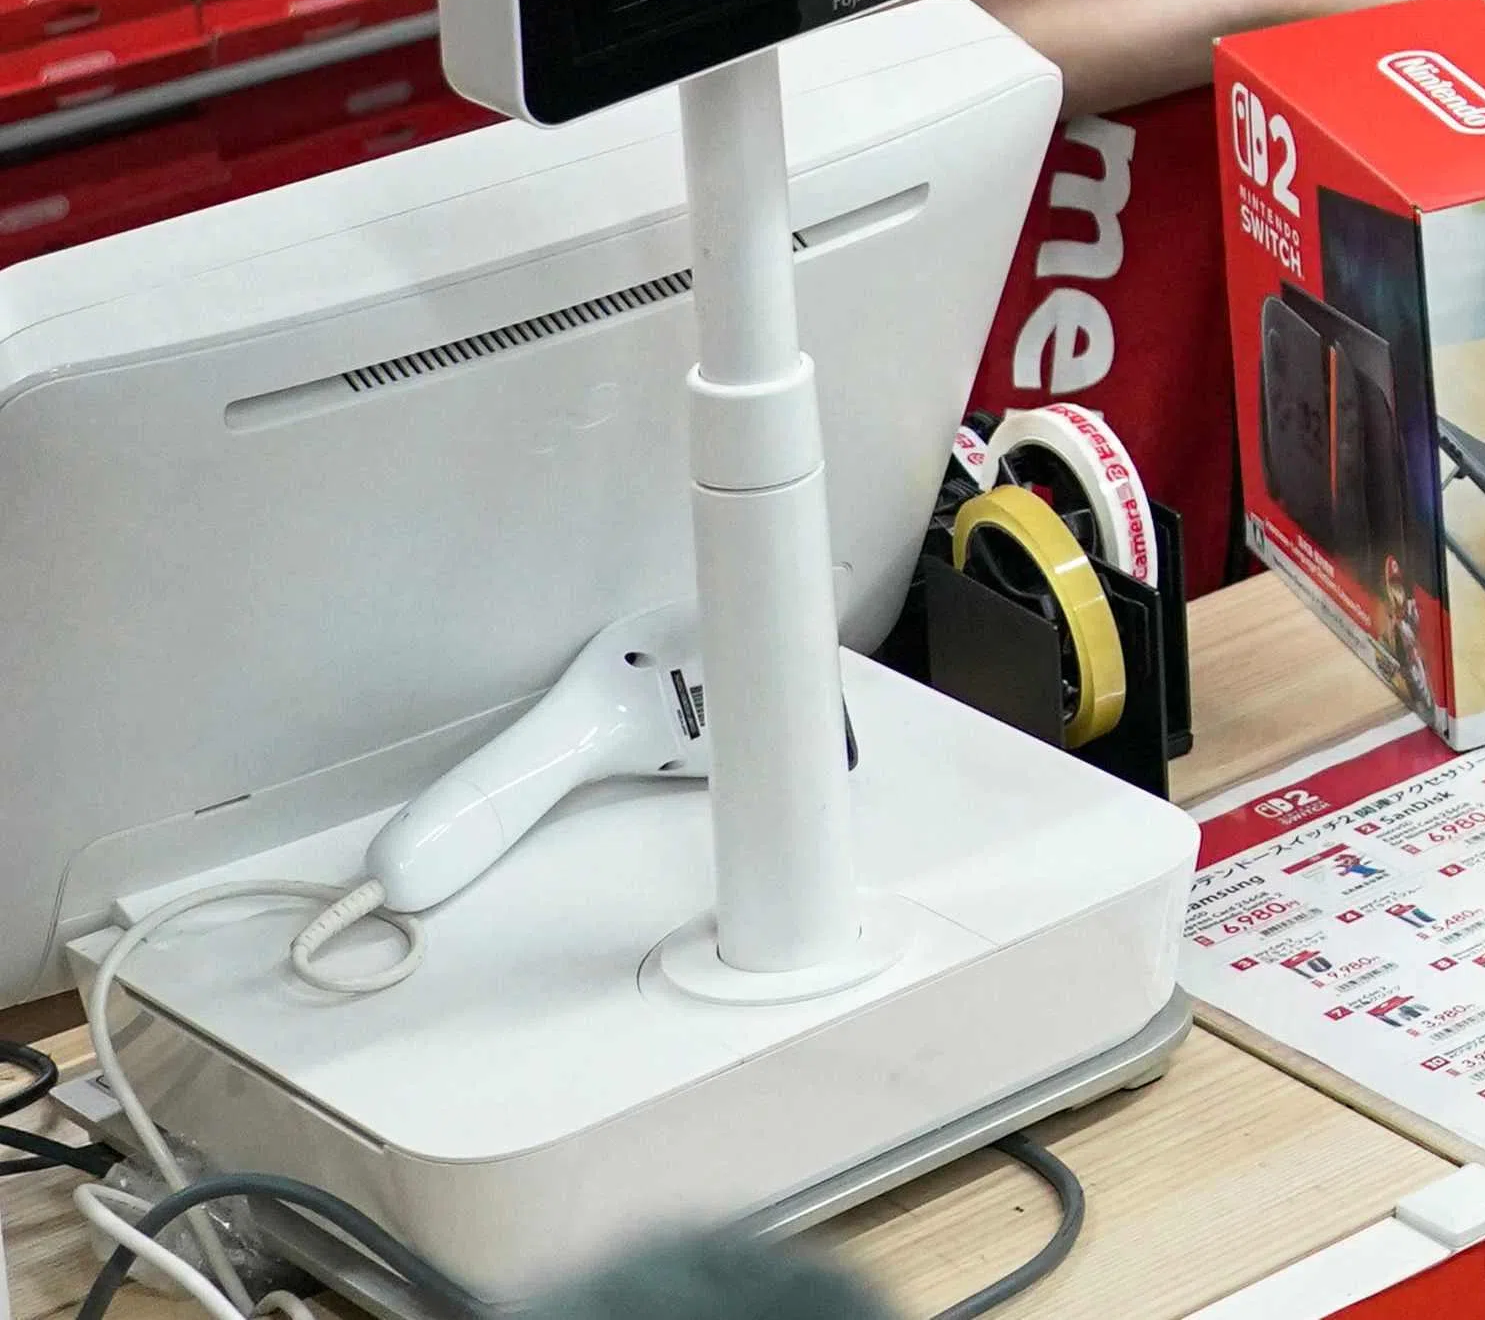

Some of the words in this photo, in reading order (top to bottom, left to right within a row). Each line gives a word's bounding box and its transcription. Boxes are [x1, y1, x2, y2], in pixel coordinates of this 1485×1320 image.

[1239, 183, 1300, 247] NINTENDO
[1240, 204, 1302, 280] SWITCH
[1381, 790, 1455, 826] SanDisk
